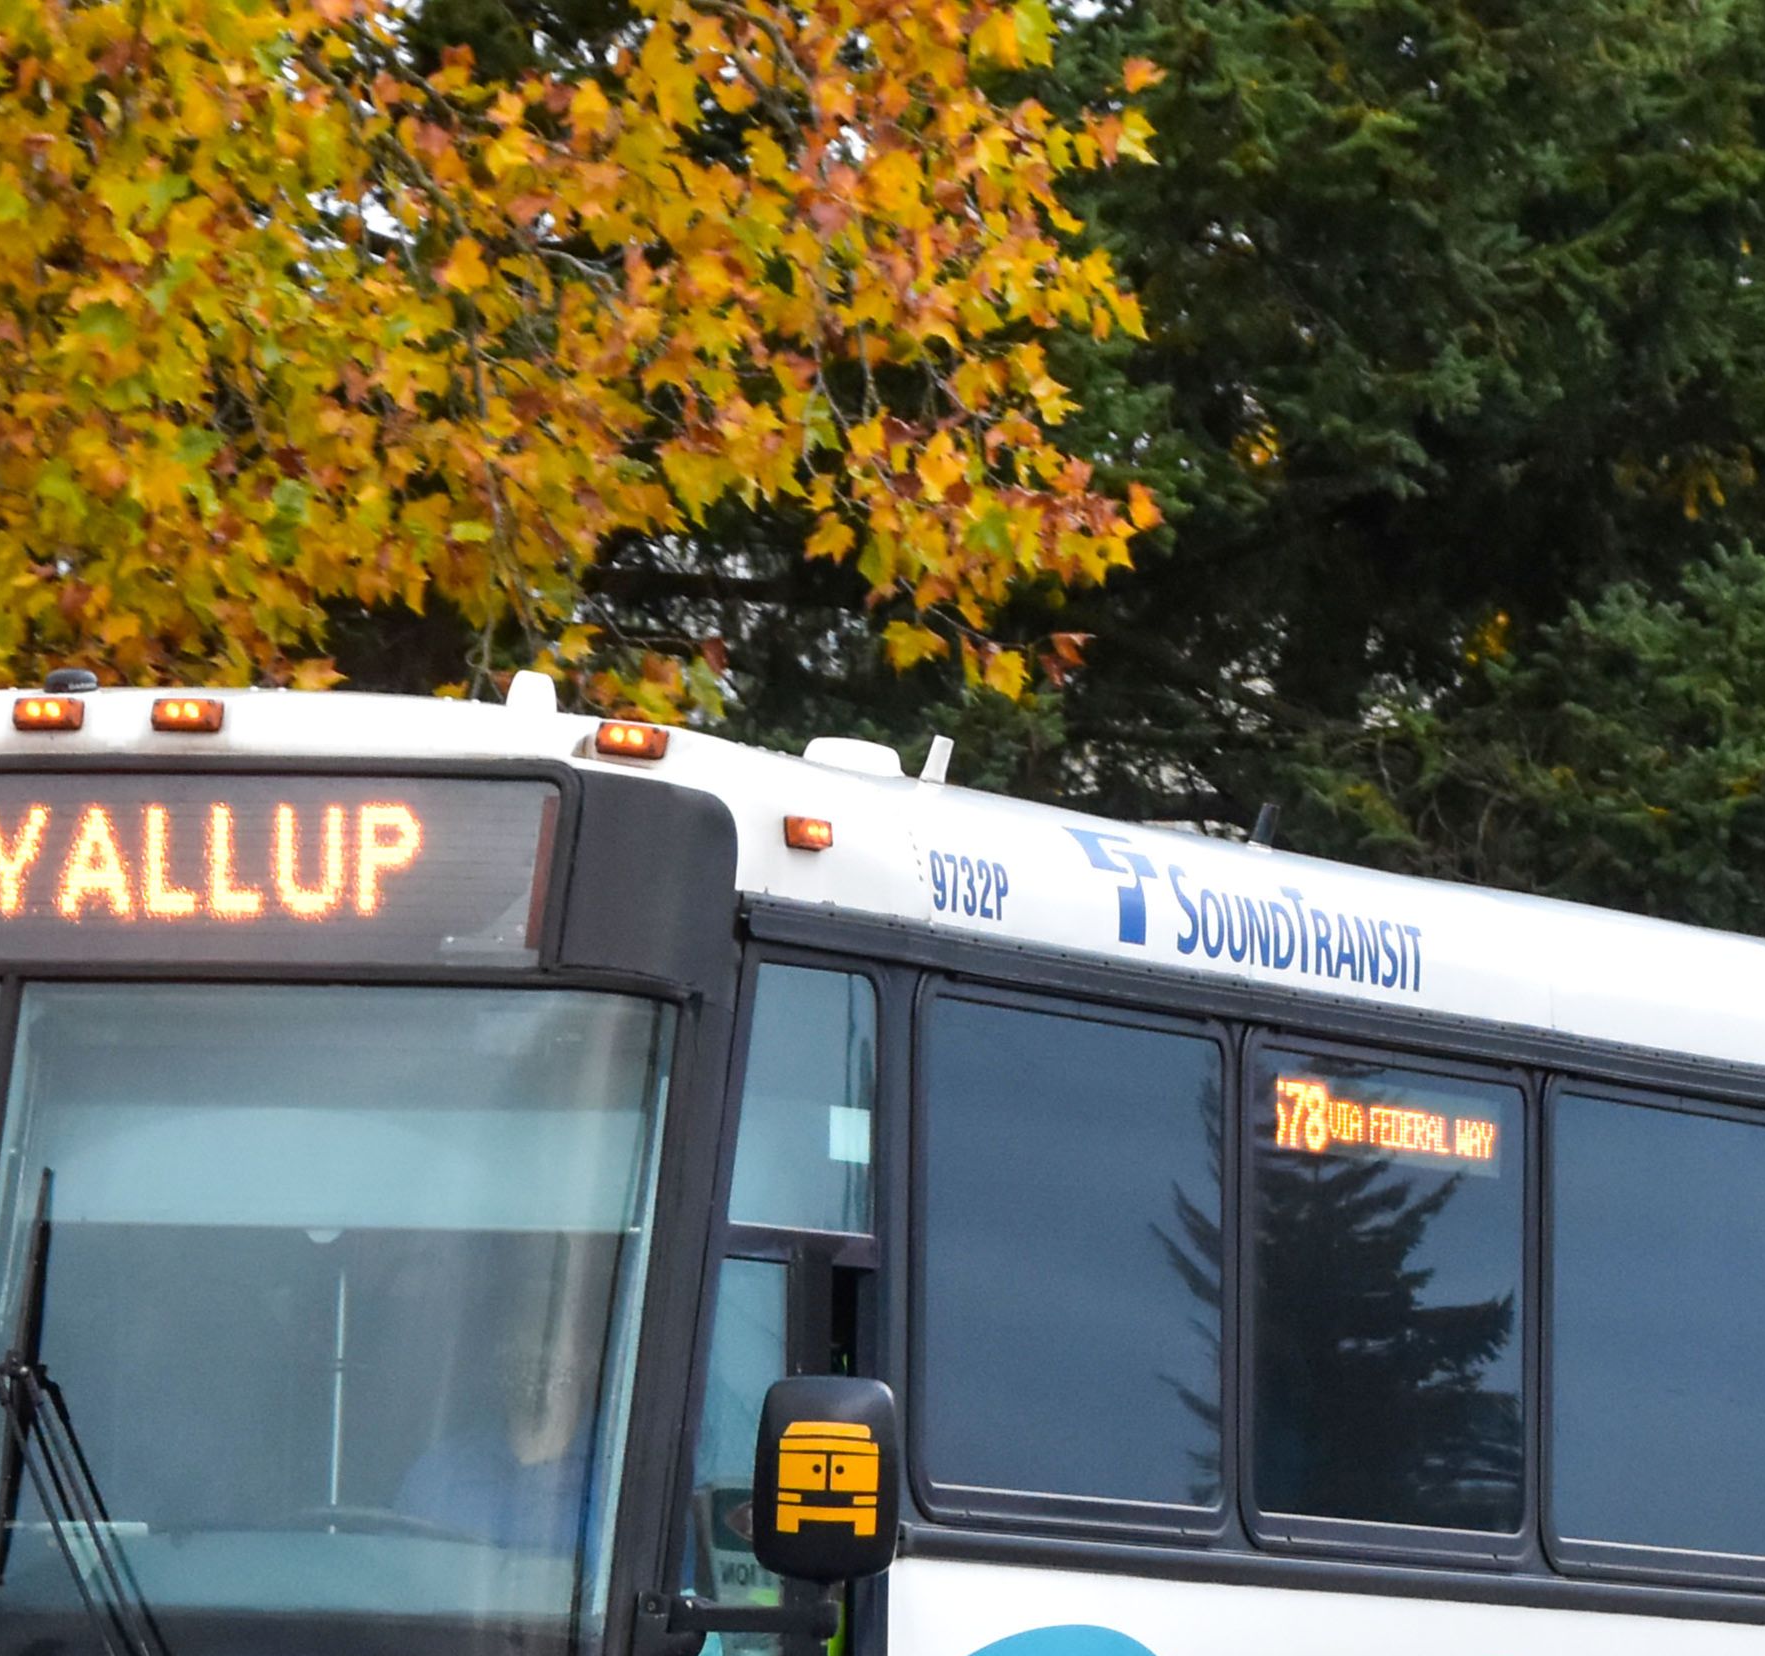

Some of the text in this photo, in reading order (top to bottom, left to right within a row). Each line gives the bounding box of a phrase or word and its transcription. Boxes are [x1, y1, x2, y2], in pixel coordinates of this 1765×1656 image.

[930, 850, 1009, 921] 9732P
[1328, 1101, 1363, 1142] VIA
[1369, 1106, 1450, 1154] FEDERAL
[1455, 1118, 1496, 1159] WAY
